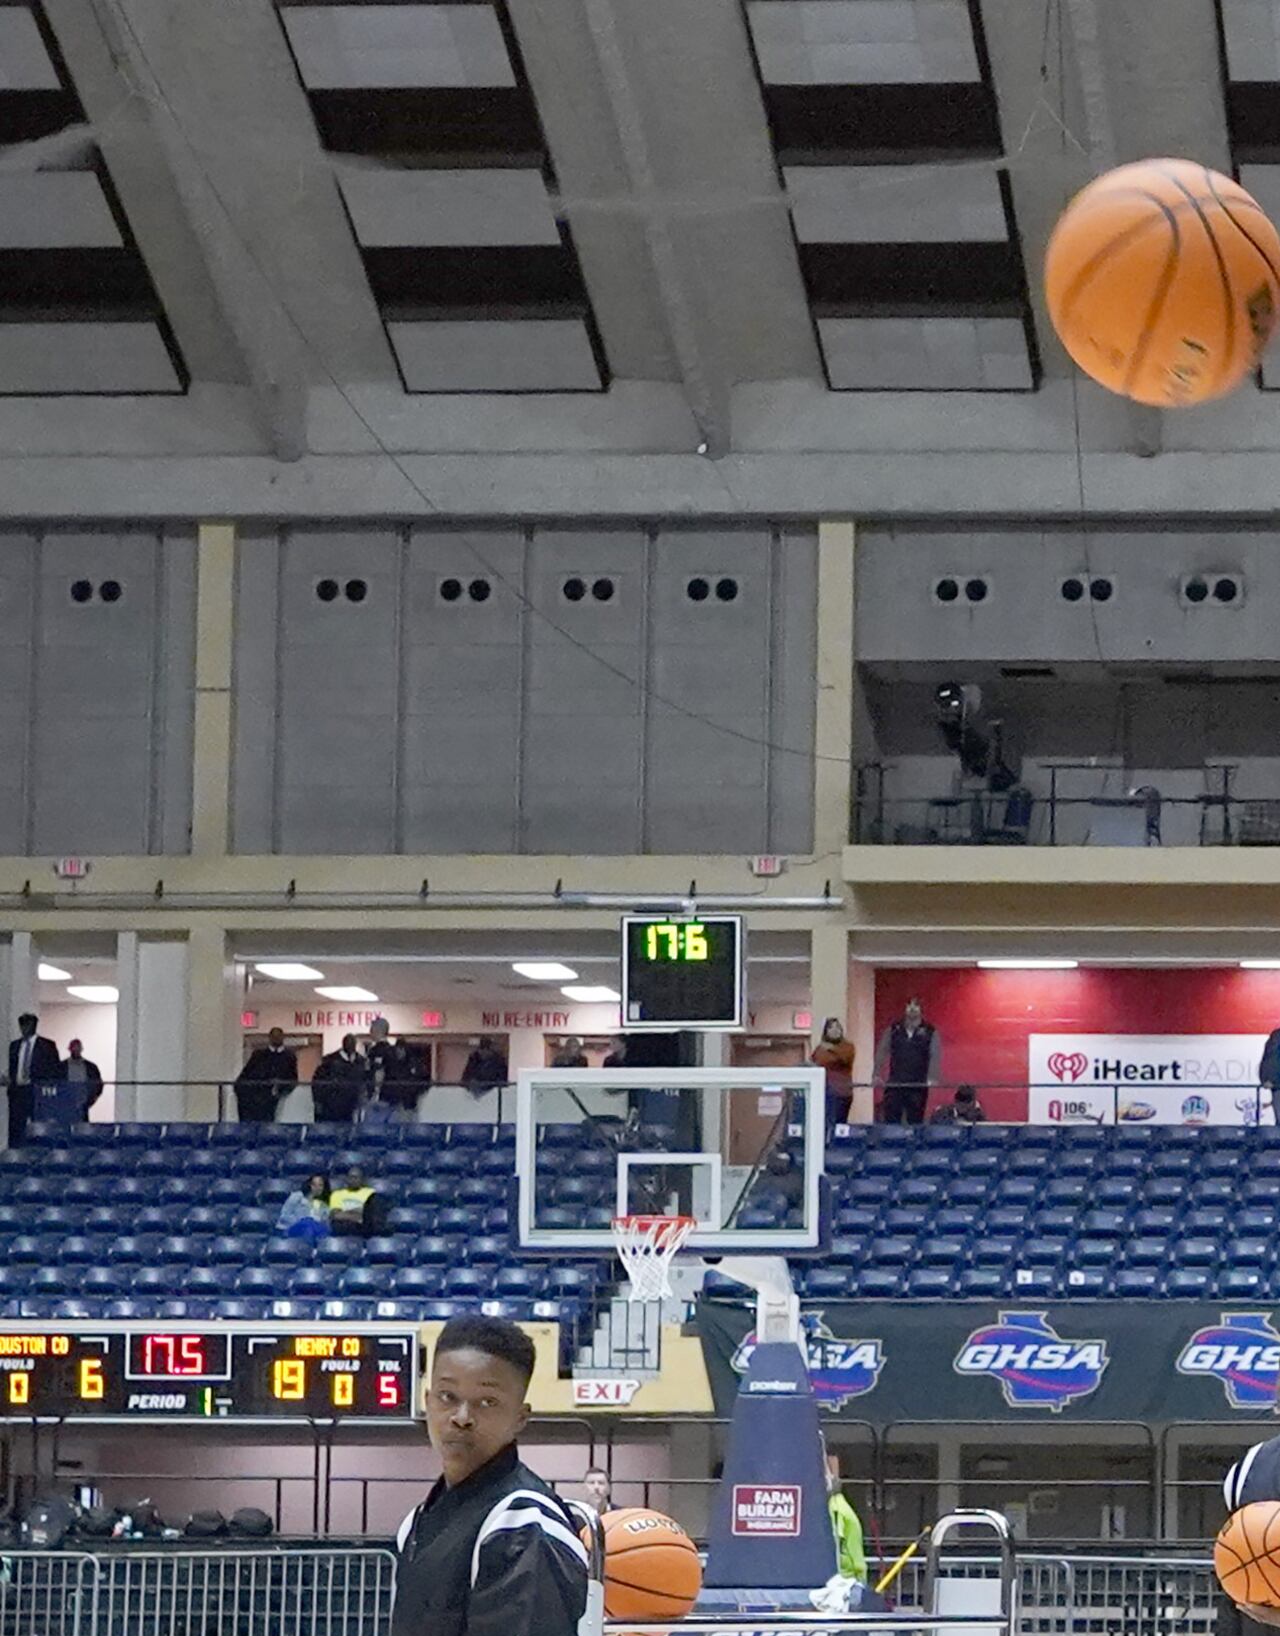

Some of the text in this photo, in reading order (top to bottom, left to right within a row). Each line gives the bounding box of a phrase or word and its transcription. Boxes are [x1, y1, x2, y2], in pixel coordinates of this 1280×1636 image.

[294, 1011, 313, 1026] NO
[482, 1011, 499, 1026] NO
[1093, 1057, 1261, 1082] iHeartRADI
[51, 1336, 69, 1355] CO
[295, 1337, 361, 1356] HENRY CO
[144, 1337, 202, 1374] 17.5
[321, 1359, 361, 1371] FOULS
[958, 1344, 1101, 1370] GHSA
[80, 1359, 104, 1399] 6
[274, 1360, 305, 1399] 19
[379, 1375, 398, 1404] 5
[127, 1394, 187, 1410] PERIOD
[754, 1491, 794, 1504] FARM
[737, 1504, 795, 1518] BUREAU
